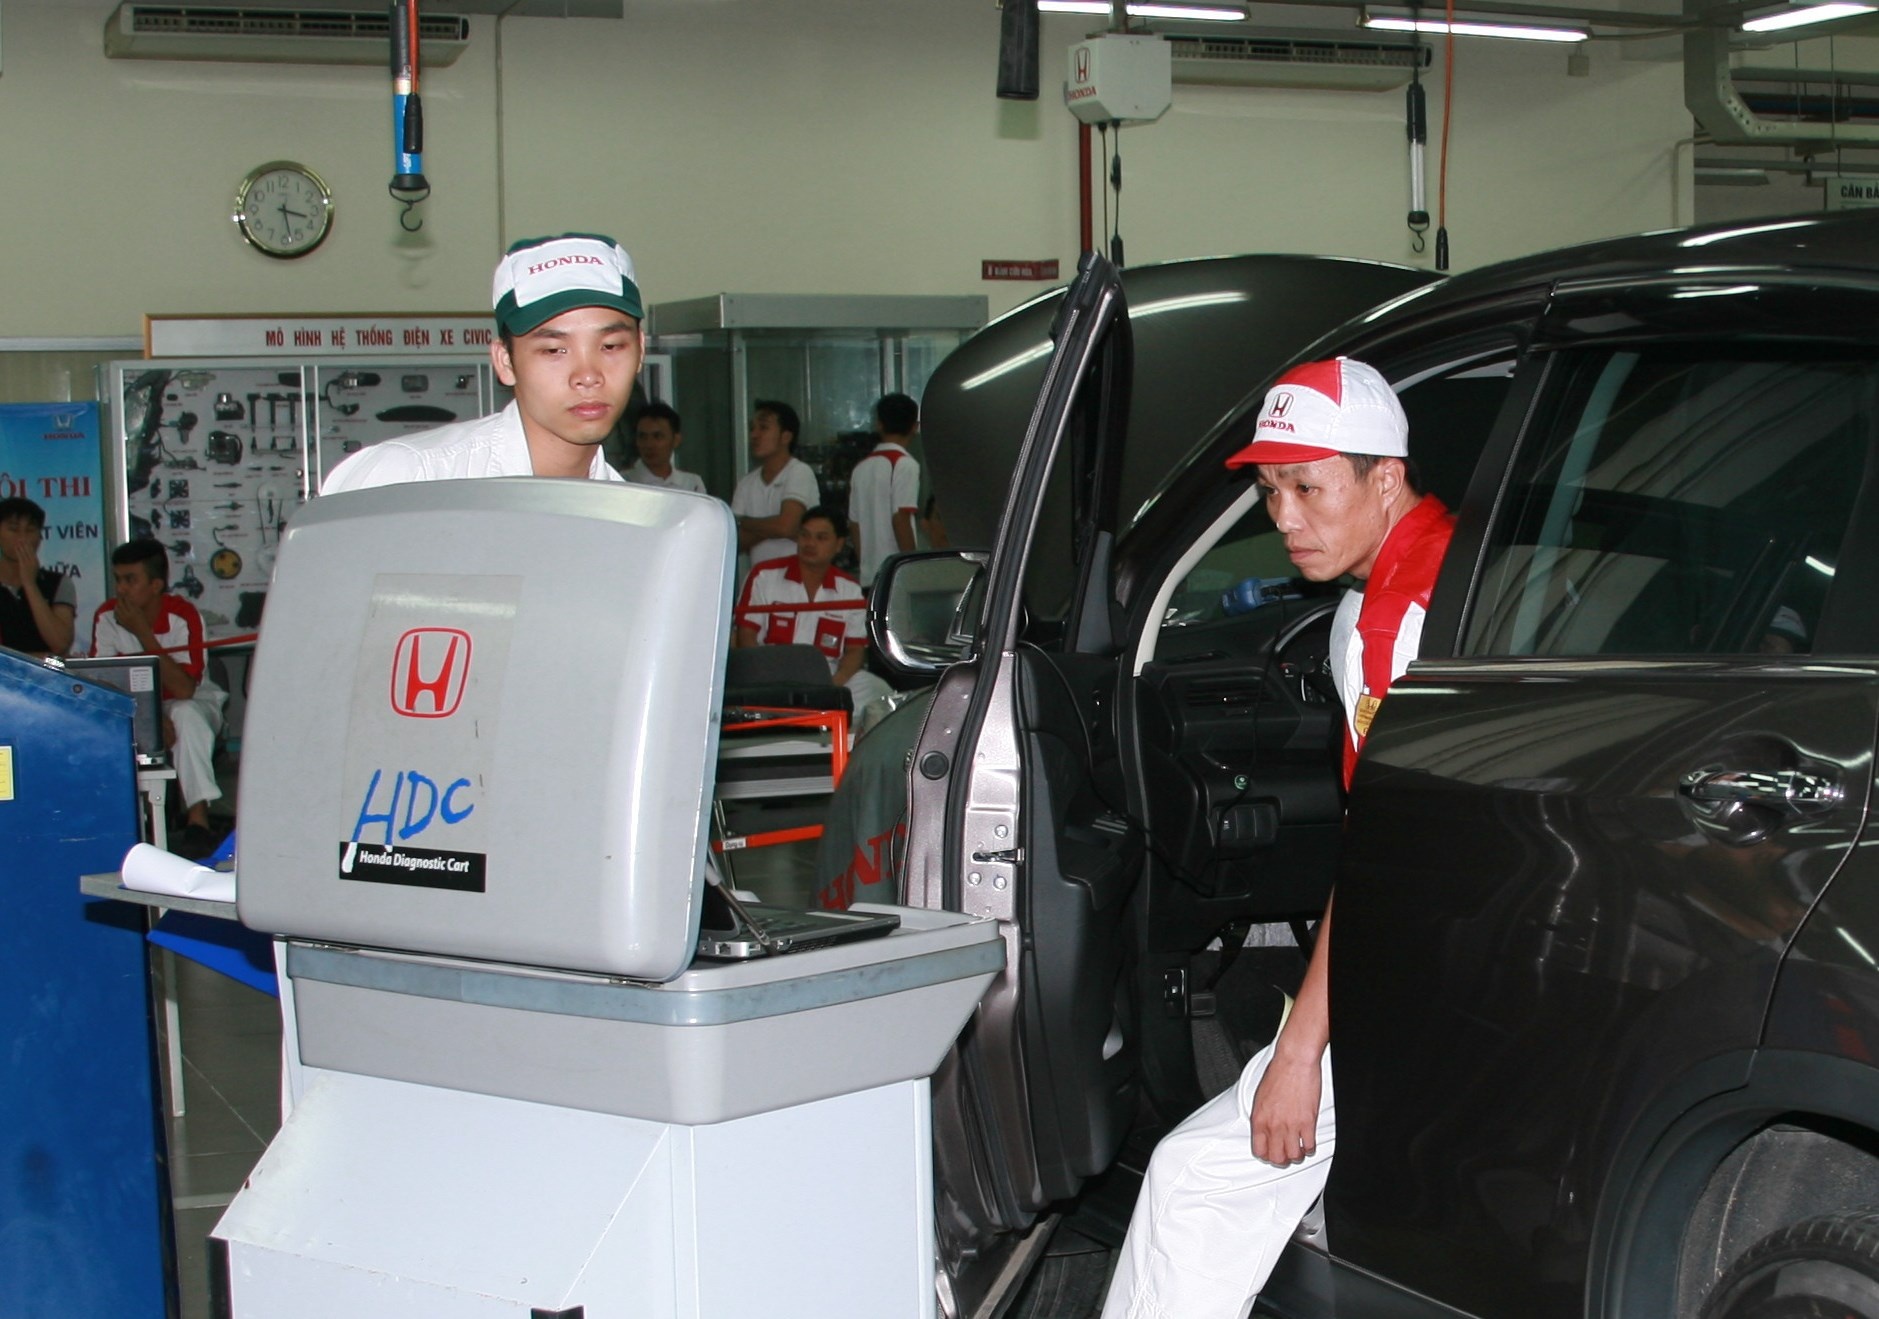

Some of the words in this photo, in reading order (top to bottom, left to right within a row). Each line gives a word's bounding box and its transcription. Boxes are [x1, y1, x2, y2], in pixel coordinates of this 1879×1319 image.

[1068, 86, 1097, 101] HONDA
[528, 255, 605, 275] HONDA
[265, 326, 284, 346] MÔ
[294, 326, 322, 346] HÌNH
[331, 326, 346, 350] HỆ
[356, 324, 393, 346] THỐNG
[403, 326, 430, 349] ĐIỆN
[440, 328, 454, 345] XE
[463, 328, 492, 345] CIVIC
[1258, 420, 1296, 433] HONDA
[37, 476, 91, 498] THI
[57, 521, 98, 540] VIÊN
[341, 768, 475, 873] HDC
[360, 850, 393, 866] Honda
[394, 853, 447, 871] Diagnostic
[447, 858, 470, 872] Cart
